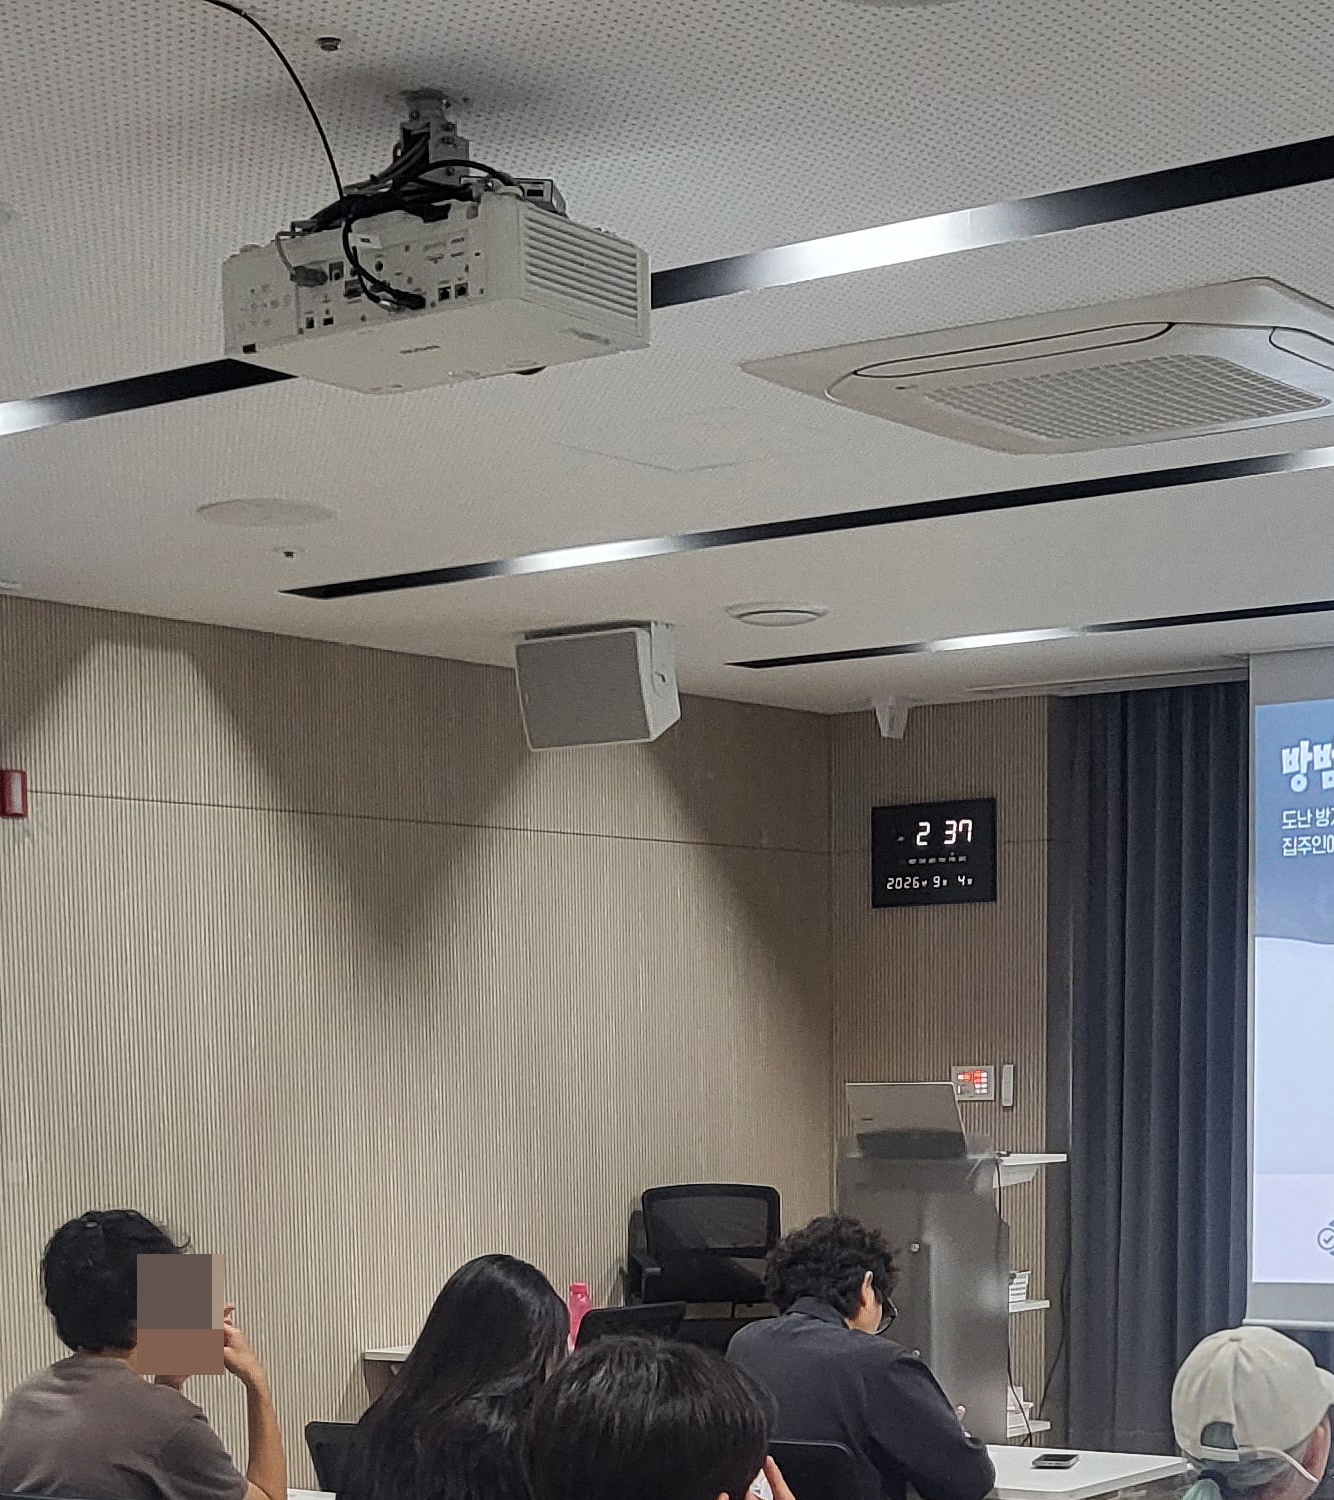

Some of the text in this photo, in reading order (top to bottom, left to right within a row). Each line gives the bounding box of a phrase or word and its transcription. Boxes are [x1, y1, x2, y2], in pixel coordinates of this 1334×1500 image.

[1282, 808, 1313, 830] 도난
[916, 819, 973, 846] 2 37
